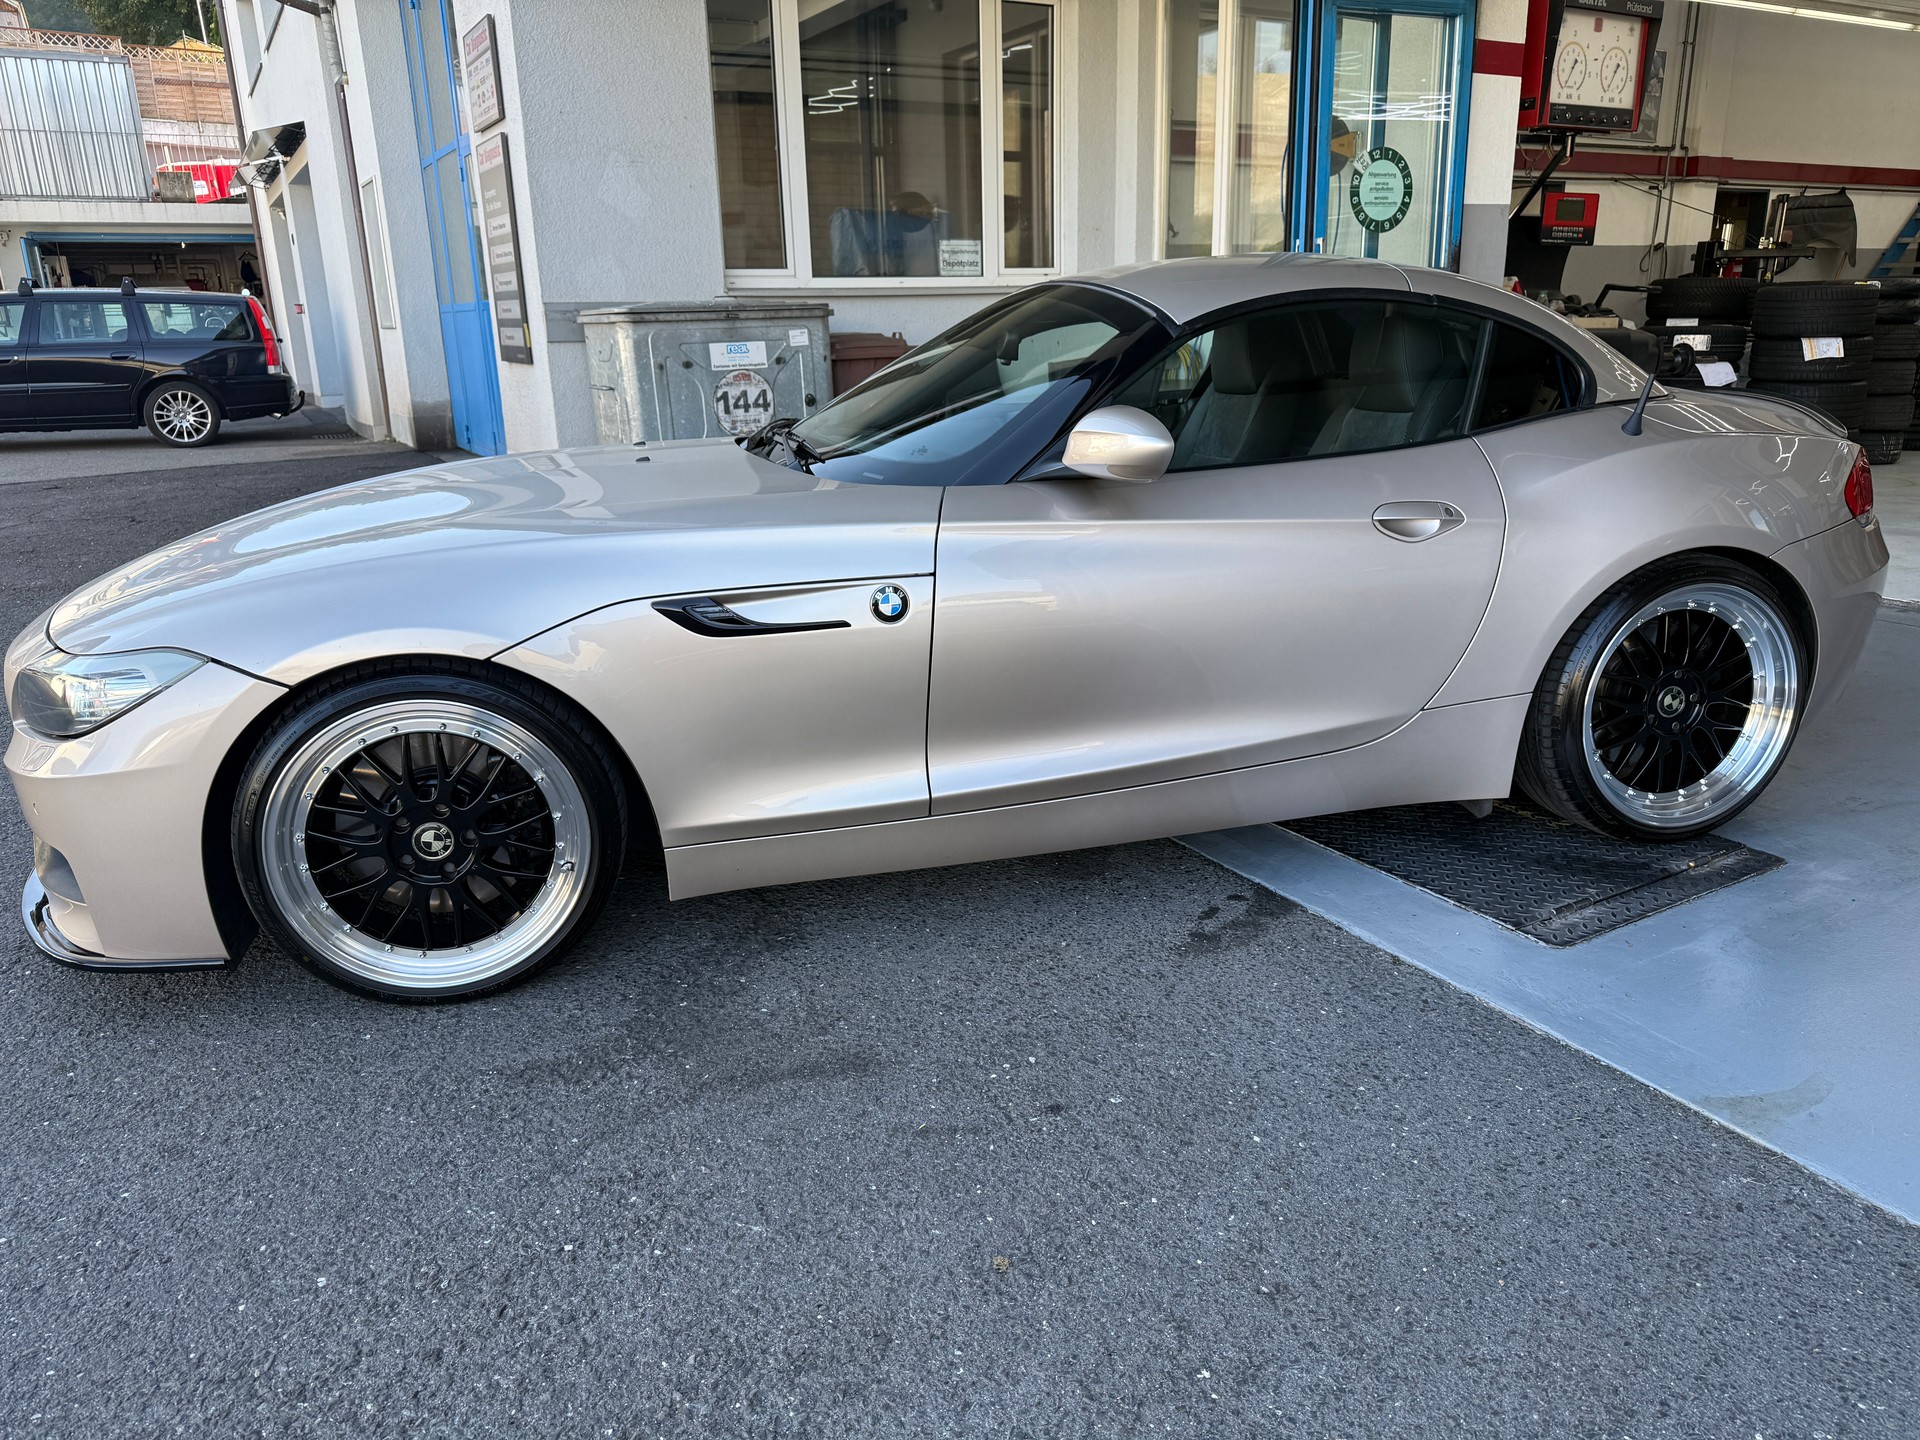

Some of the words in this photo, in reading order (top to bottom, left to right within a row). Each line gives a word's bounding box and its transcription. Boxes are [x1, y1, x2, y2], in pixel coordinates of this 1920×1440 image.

[1626, 1, 1653, 14] Prüfstand
[1372, 150, 1381, 159] 12
[1388, 150, 1393, 159] 1
[1398, 160, 1405, 169] 2
[1353, 175, 1360, 186] 10
[1352, 196, 1359, 204] 9
[1404, 195, 1410, 203] 4
[1358, 212, 1365, 220] 8
[1396, 211, 1403, 220] 5
[1370, 221, 1376, 230] 7
[1384, 221, 1390, 229] 6
[942, 260, 979, 268] Depotplatz
[715, 389, 770, 415] 144
[875, 587, 904, 599] BMW
[1577, 645, 1593, 673] OUTSIDE
